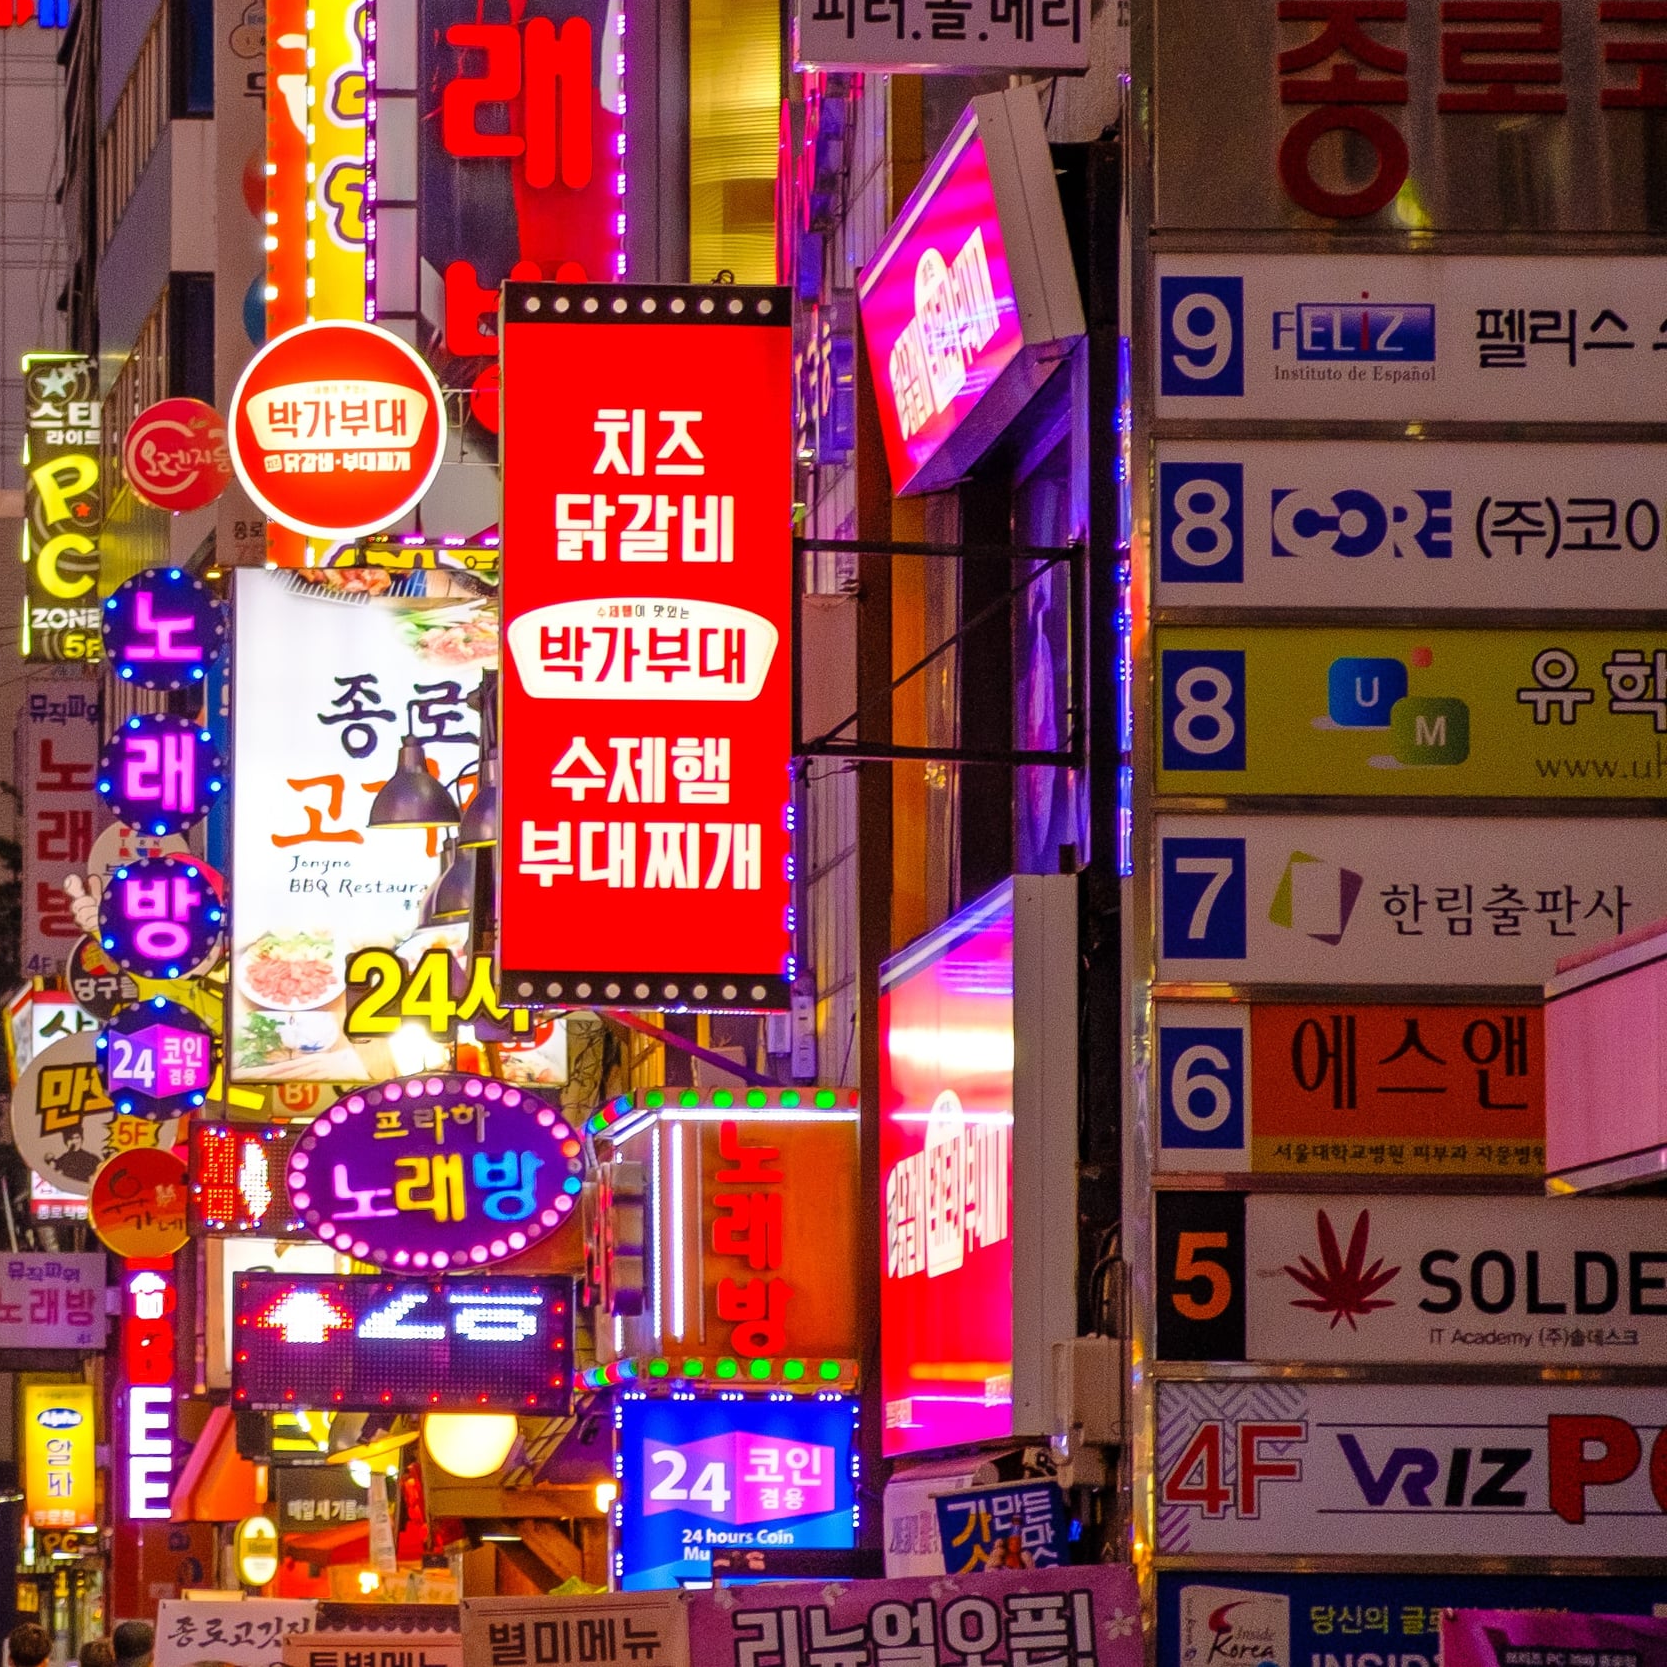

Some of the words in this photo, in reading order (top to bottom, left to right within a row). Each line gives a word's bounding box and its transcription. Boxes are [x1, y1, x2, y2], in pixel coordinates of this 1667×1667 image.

[1172, 293, 1233, 380] 9
[1476, 308, 1635, 368] 펠리스
[1273, 365, 1344, 382] Instituto
[1347, 365, 1367, 382] de
[1372, 365, 1437, 385] Español
[267, 398, 407, 438] 박가부대
[593, 408, 705, 476] 치즈
[32, 454, 99, 599] PC
[555, 493, 735, 563] 닭갈비
[1171, 479, 1233, 567] 8
[1271, 488, 1453, 558] CORE
[31, 607, 100, 629] ZONE
[539, 626, 747, 685] 박가부대
[1173, 666, 1235, 755] 8
[124, 591, 203, 960] 노래방
[550, 736, 732, 805] 수제햄
[288, 854, 352, 874] Jongno
[518, 820, 763, 891] 부대찌개
[289, 879, 331, 897] BBQ
[1175, 857, 1234, 939] 7
[1380, 883, 1633, 937] 한림출판사
[112, 1039, 155, 1087] 24
[160, 1037, 203, 1067] 코인
[1171, 1044, 1232, 1132] 6
[1291, 1015, 1530, 1110] 에스앤
[117, 1122, 149, 1146] 5F
[372, 1102, 491, 1145] 프라하
[1272, 1143, 1405, 1166] 서울대학교병원
[1413, 1143, 1468, 1165] 피부과
[331, 1150, 546, 1223] 노래방
[712, 1120, 794, 1359] 노래방
[1171, 1231, 1233, 1321] 5
[1451, 1328, 1534, 1348] Academy
[46, 1438, 75, 1499] 알파
[648, 1451, 731, 1513] 24
[744, 1447, 823, 1487] 코인
[758, 1488, 805, 1511] 겸용
[1162, 1420, 1308, 1520] 4F
[681, 1529, 704, 1545] 24
[705, 1529, 755, 1545] hours
[756, 1529, 795, 1545] Coin
[489, 1618, 661, 1666] 별미메뉴
[1310, 1605, 1391, 1635] 당신의
